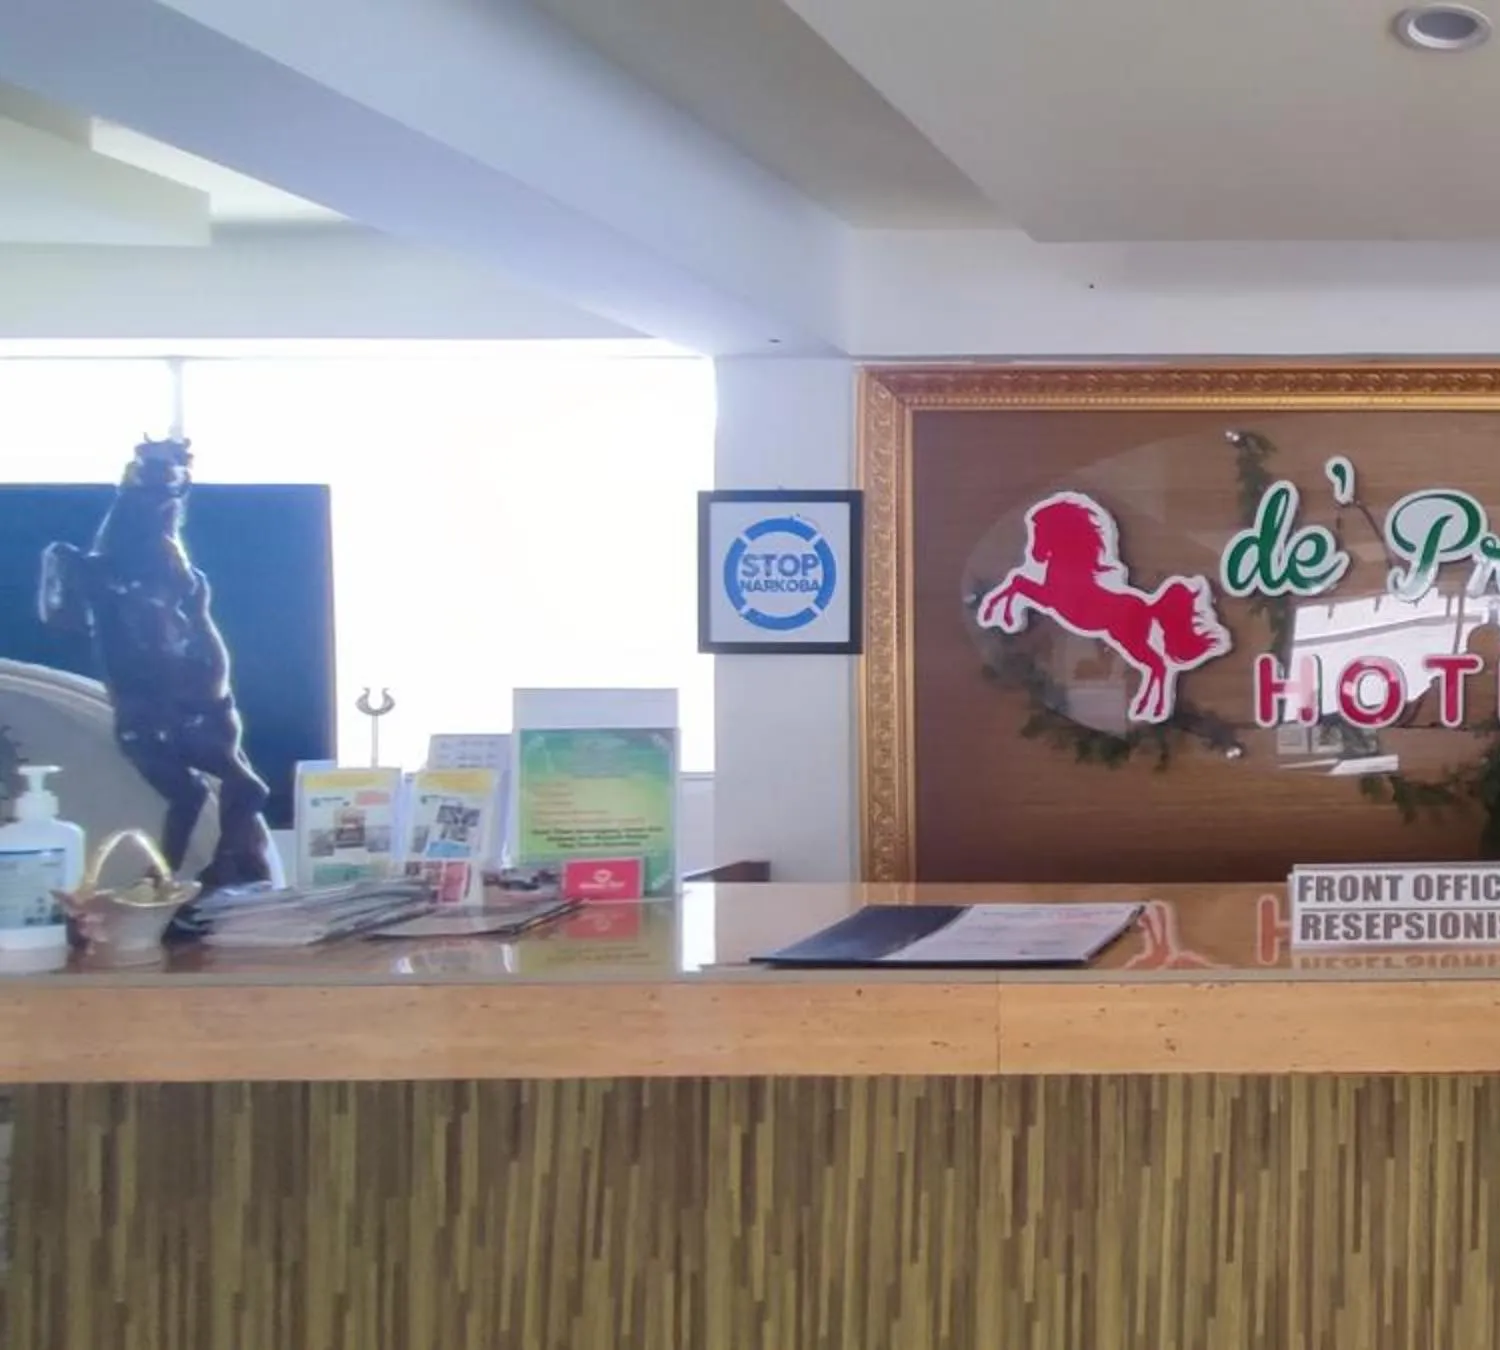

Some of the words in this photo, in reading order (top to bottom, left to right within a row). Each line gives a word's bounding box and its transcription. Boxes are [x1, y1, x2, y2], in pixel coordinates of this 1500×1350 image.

[741, 553, 820, 578] STOP
[740, 579, 822, 593] NARKOBA
[1297, 874, 1403, 903] FRONT
